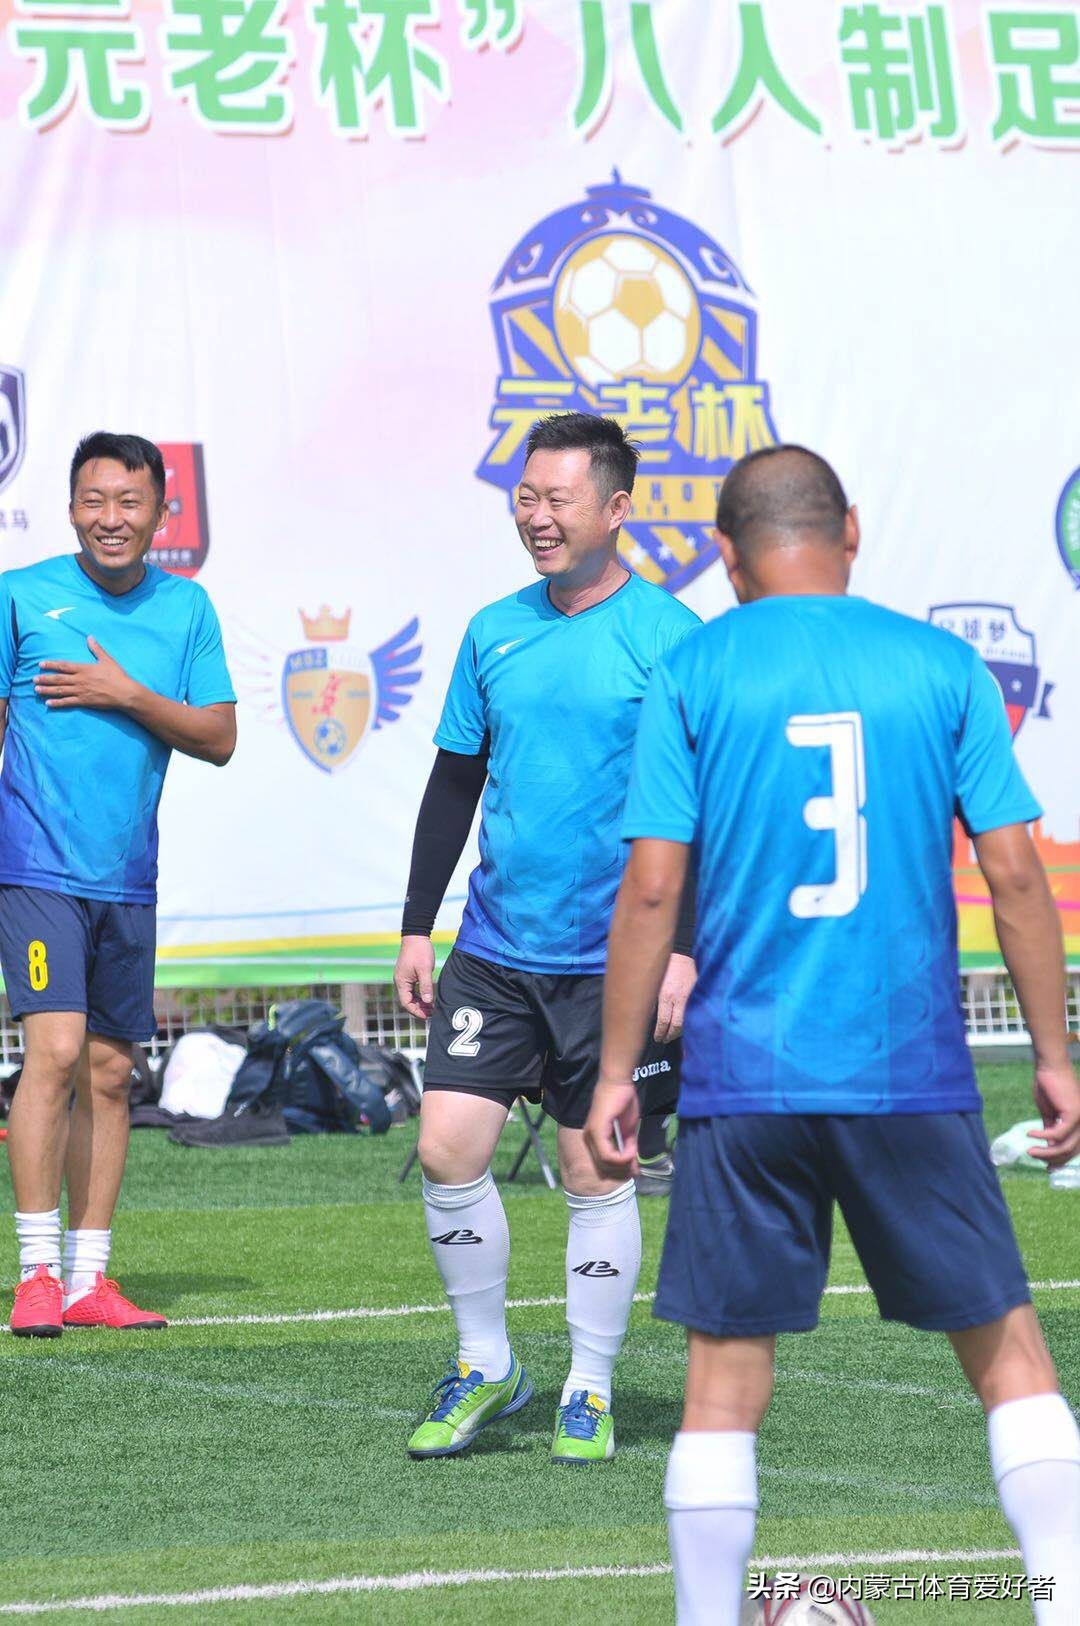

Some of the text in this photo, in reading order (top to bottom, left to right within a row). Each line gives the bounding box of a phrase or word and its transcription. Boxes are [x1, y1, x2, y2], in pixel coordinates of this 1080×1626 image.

[785, 711, 868, 920] 3
[27, 939, 49, 992] 8
[447, 1006, 484, 1057] 2
